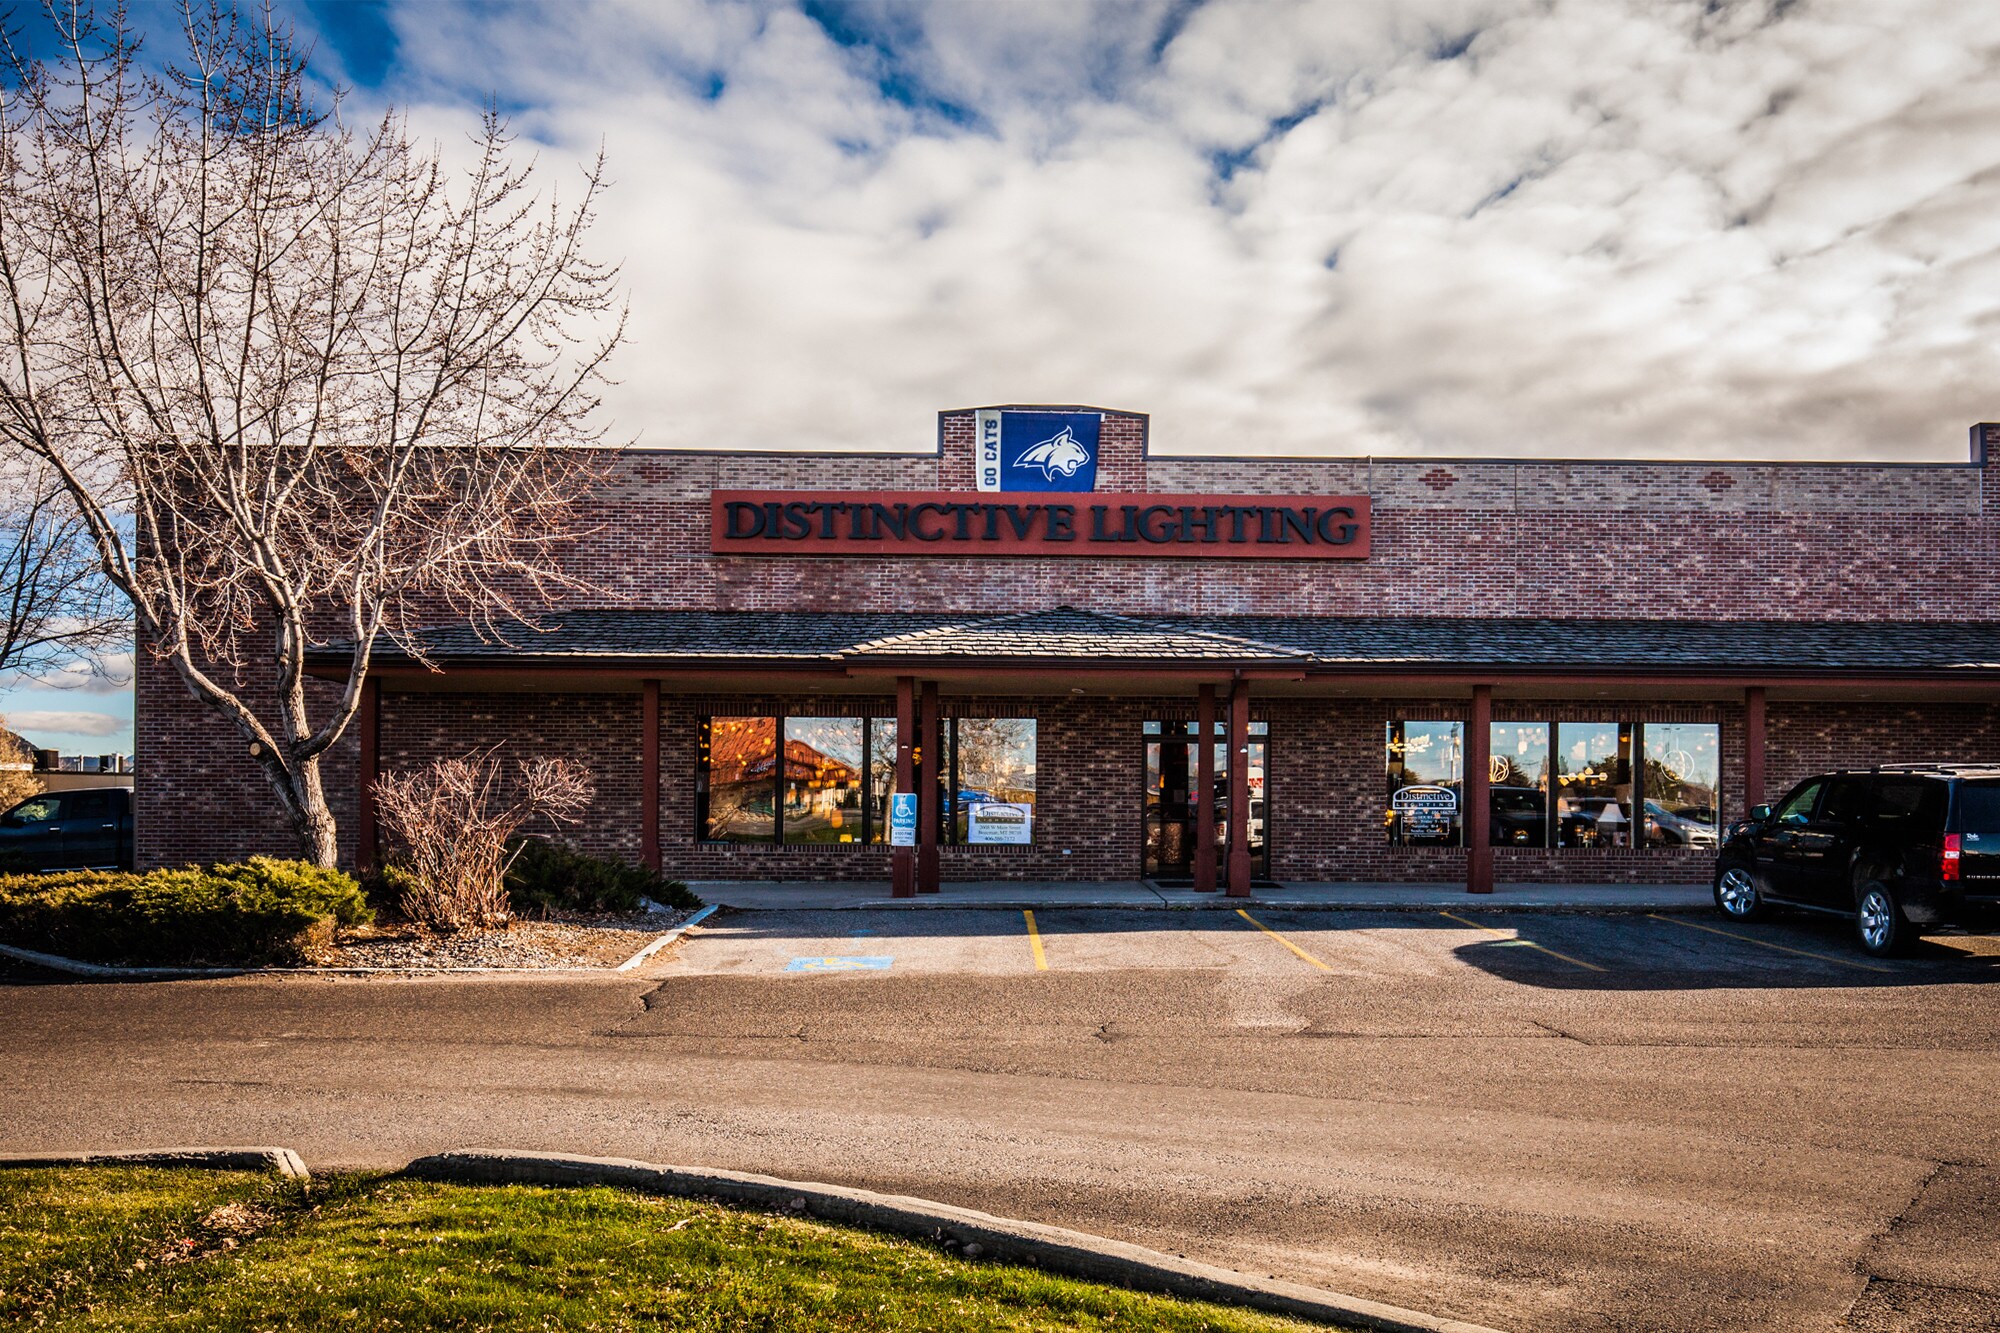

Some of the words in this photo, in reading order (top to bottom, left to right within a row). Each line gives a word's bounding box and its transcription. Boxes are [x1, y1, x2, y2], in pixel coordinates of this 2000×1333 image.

[984, 419, 998, 461] CATS
[984, 468, 997, 486] GO
[723, 501, 1076, 541] DISTINCTIVE
[1089, 504, 1359, 544] LIGHTING
[1401, 791, 1450, 800] Distinctive
